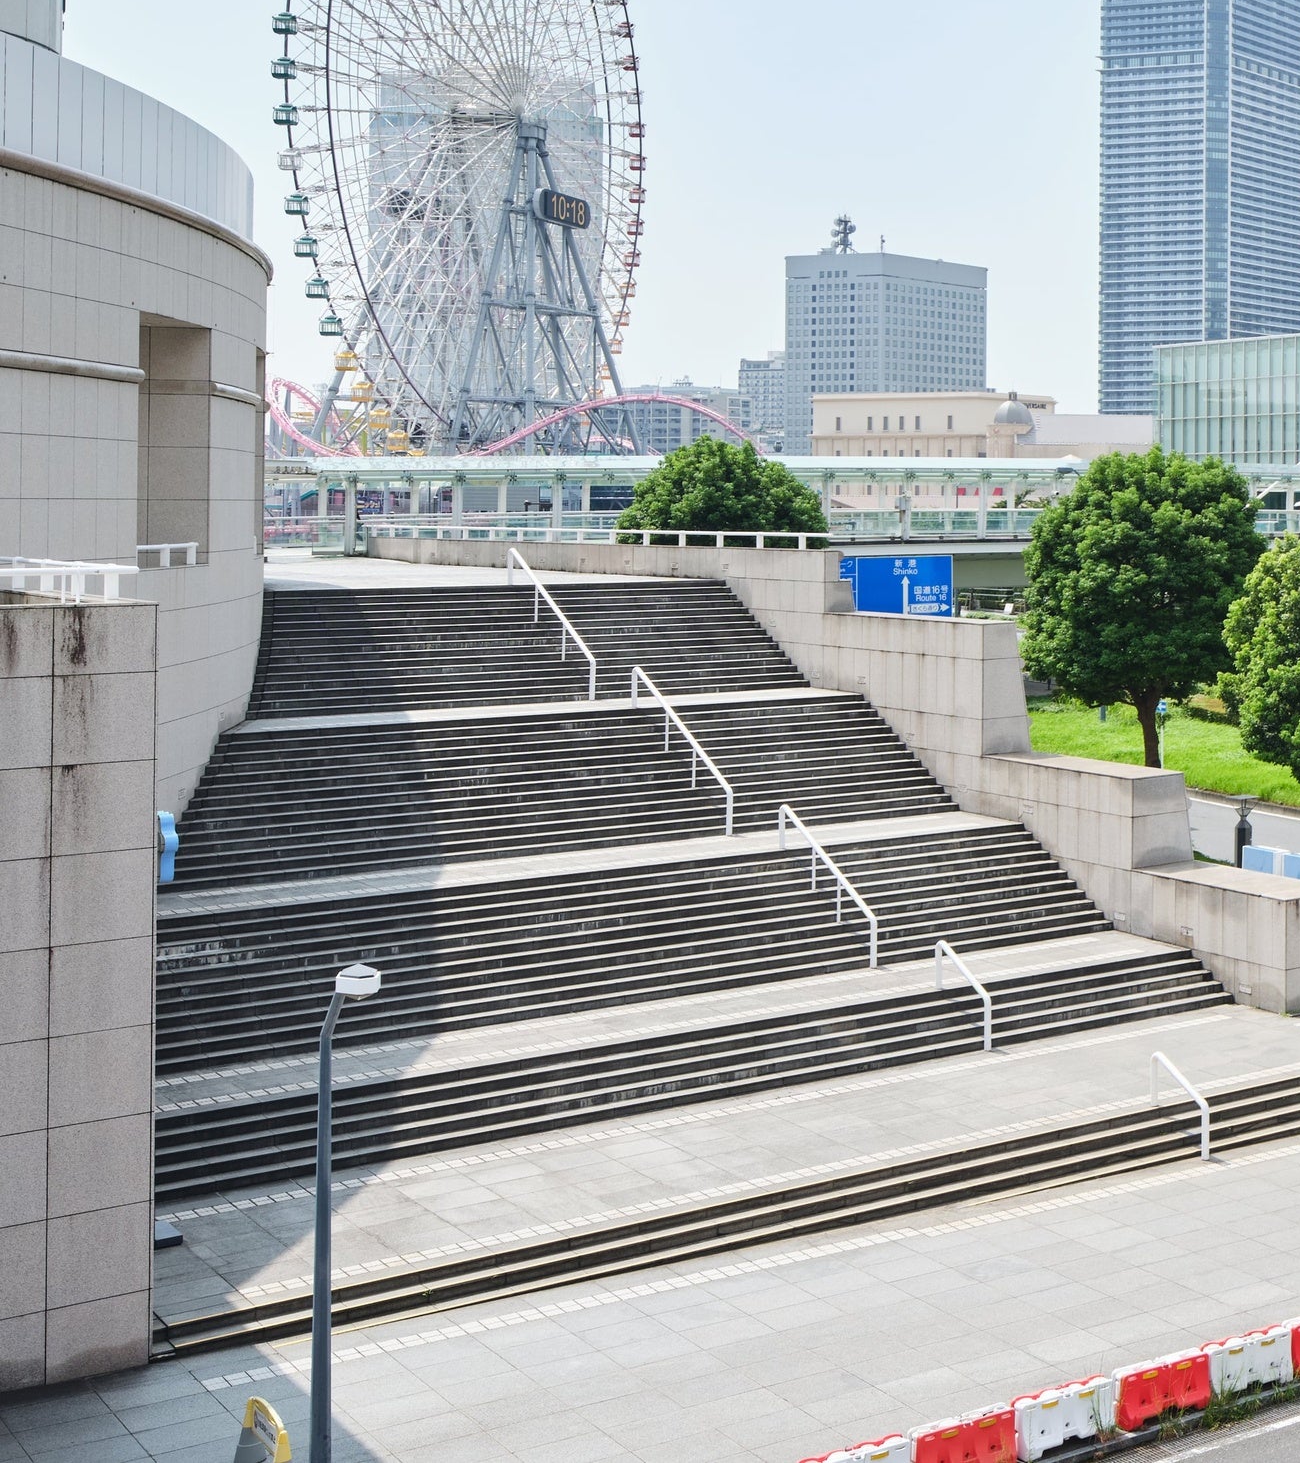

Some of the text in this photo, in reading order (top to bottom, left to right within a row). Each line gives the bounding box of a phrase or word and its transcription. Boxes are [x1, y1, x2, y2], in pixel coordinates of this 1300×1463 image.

[551, 194, 585, 226] 10:18
[894, 559, 917, 568] 新港
[893, 568, 918, 576] Shinko
[913, 585, 949, 595] 国道16号
[915, 593, 947, 602] Route 16
